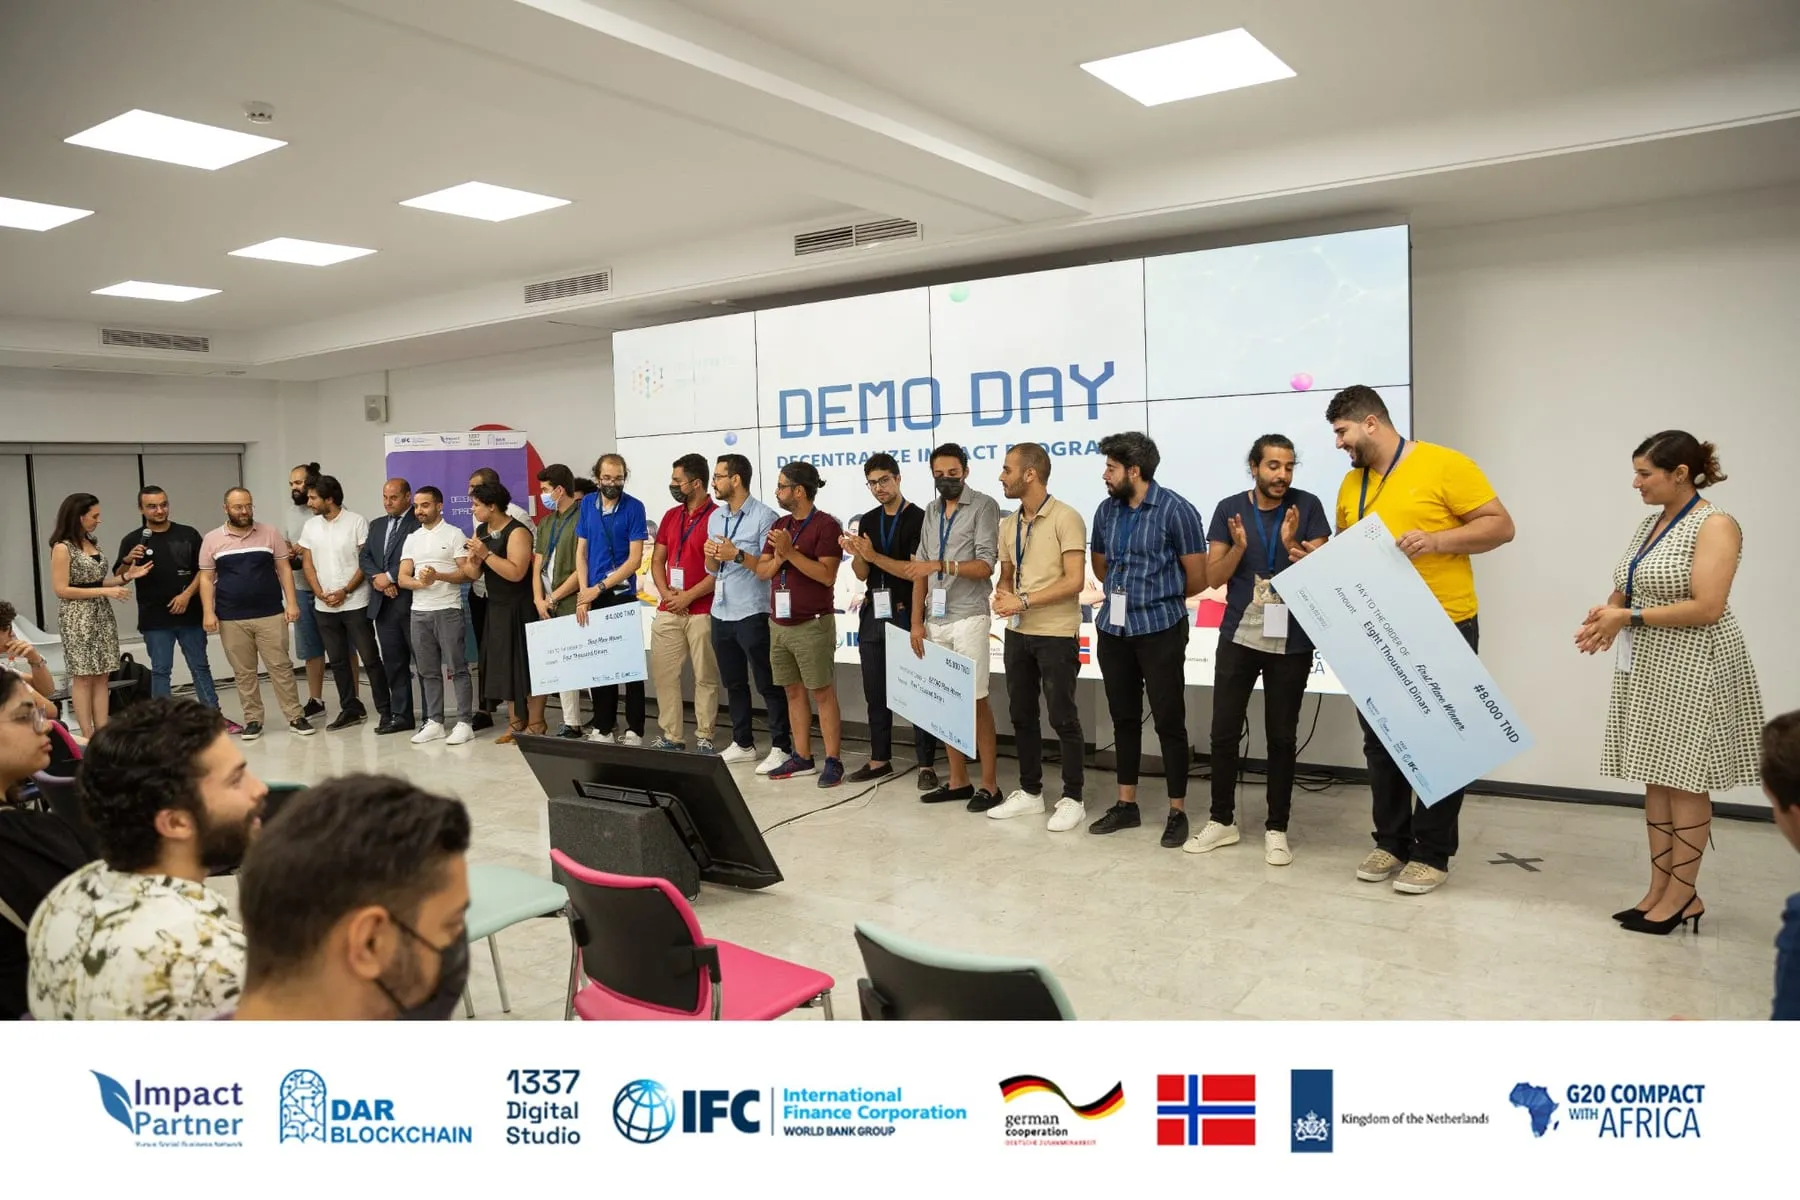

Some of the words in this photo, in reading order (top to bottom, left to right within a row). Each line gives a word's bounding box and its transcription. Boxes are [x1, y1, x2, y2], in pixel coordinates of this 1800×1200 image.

[779, 376, 942, 439] DEMO
[970, 361, 1115, 427] DAY
[777, 449, 911, 469] DECENTRAZE
[1334, 587, 1357, 614] Amount
[1355, 583, 1368, 598] PAY
[1366, 598, 1376, 609] TO
[1374, 608, 1386, 623] THE
[1383, 623, 1402, 646] ORDER
[1400, 646, 1410, 657] OF
[1363, 620, 1383, 644] Eight
[1380, 644, 1412, 686] Thousand
[1409, 686, 1431, 715] Dinars
[1473, 684, 1503, 720] #8.000
[1499, 720, 1520, 743] TND
